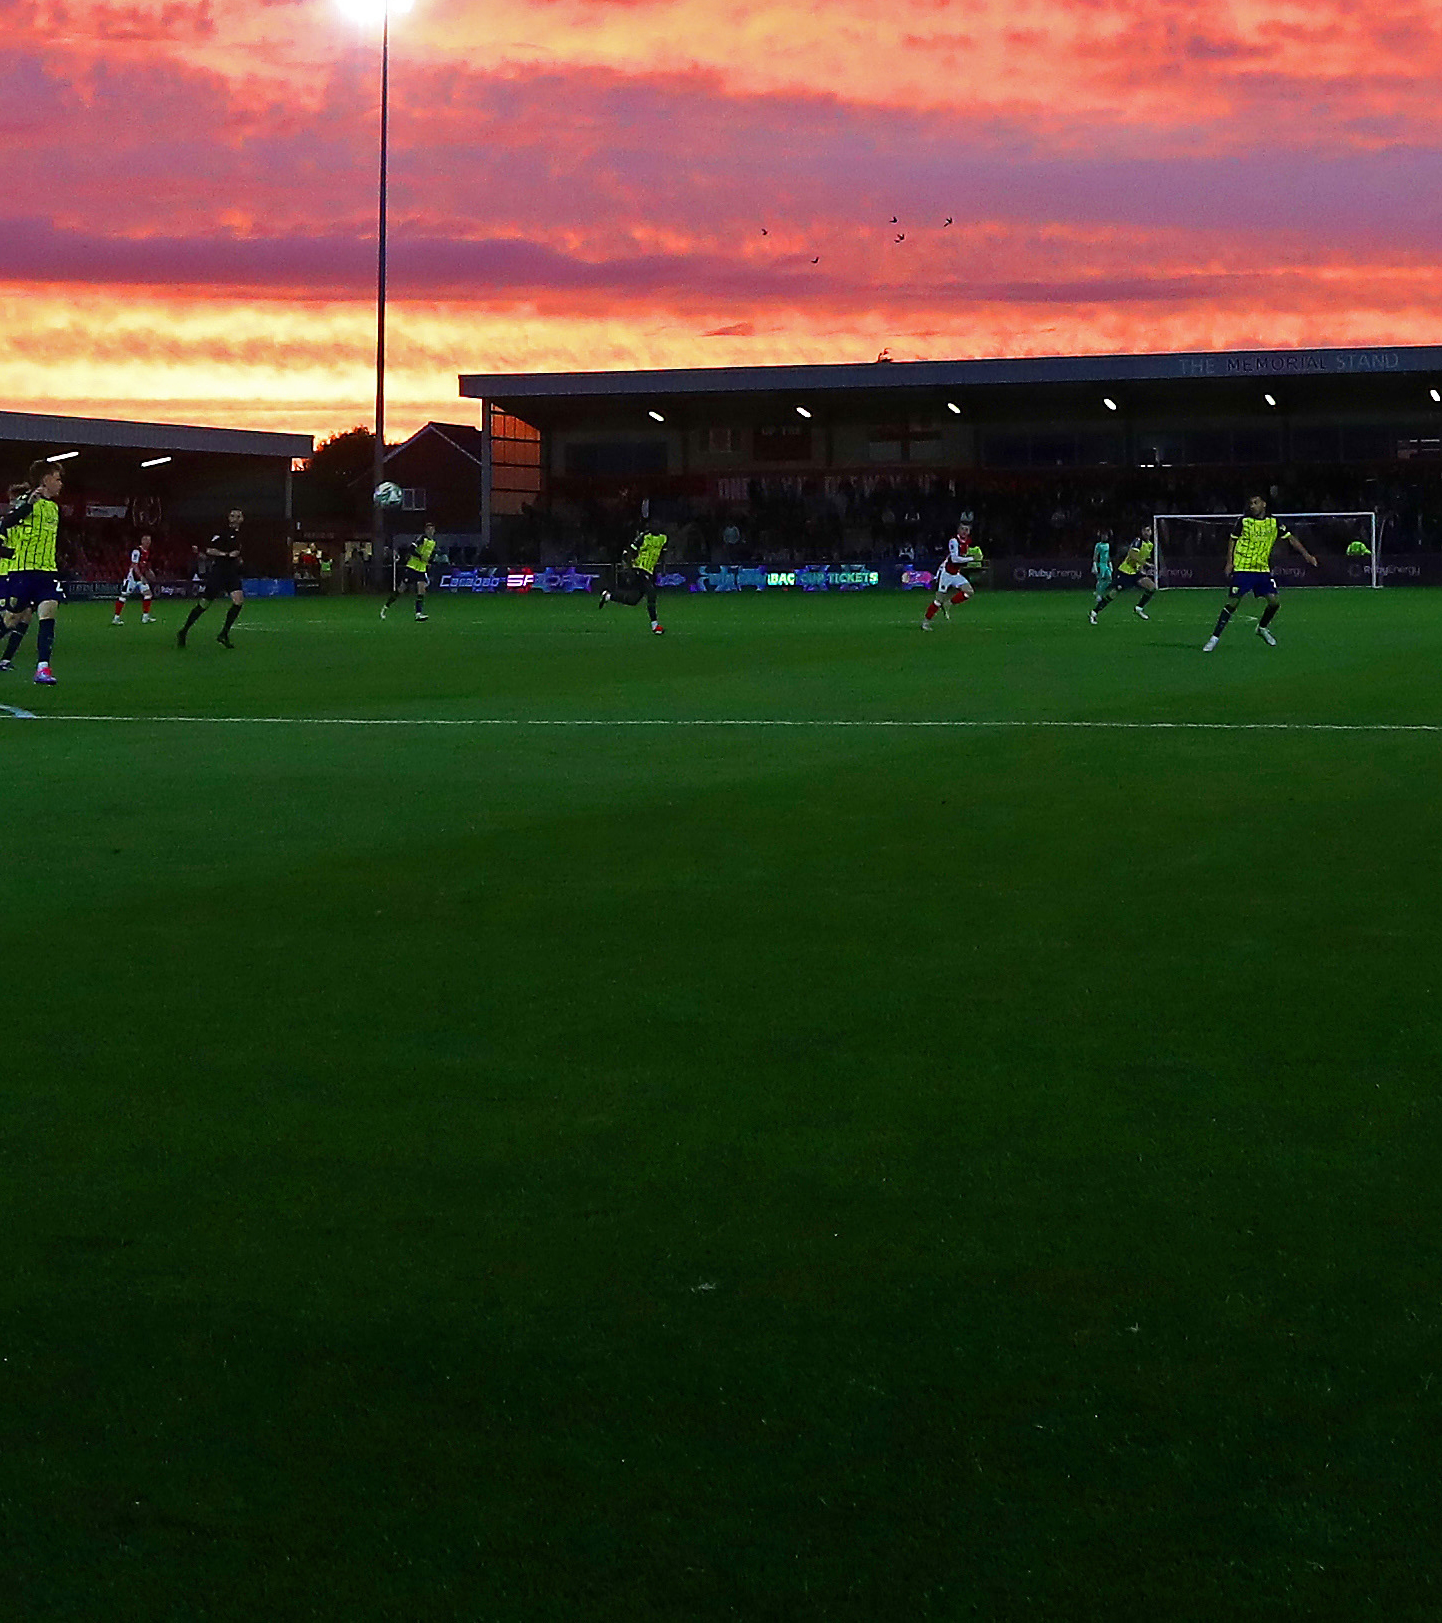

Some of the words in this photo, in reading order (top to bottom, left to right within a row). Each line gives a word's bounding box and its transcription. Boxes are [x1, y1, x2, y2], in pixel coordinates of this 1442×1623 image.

[1178, 358, 1215, 375] THE
[1226, 355, 1328, 372] MEMORIAL
[1335, 352, 1399, 370] STAND
[439, 574, 501, 588] Carabao
[828, 571, 879, 586] TICKETS
